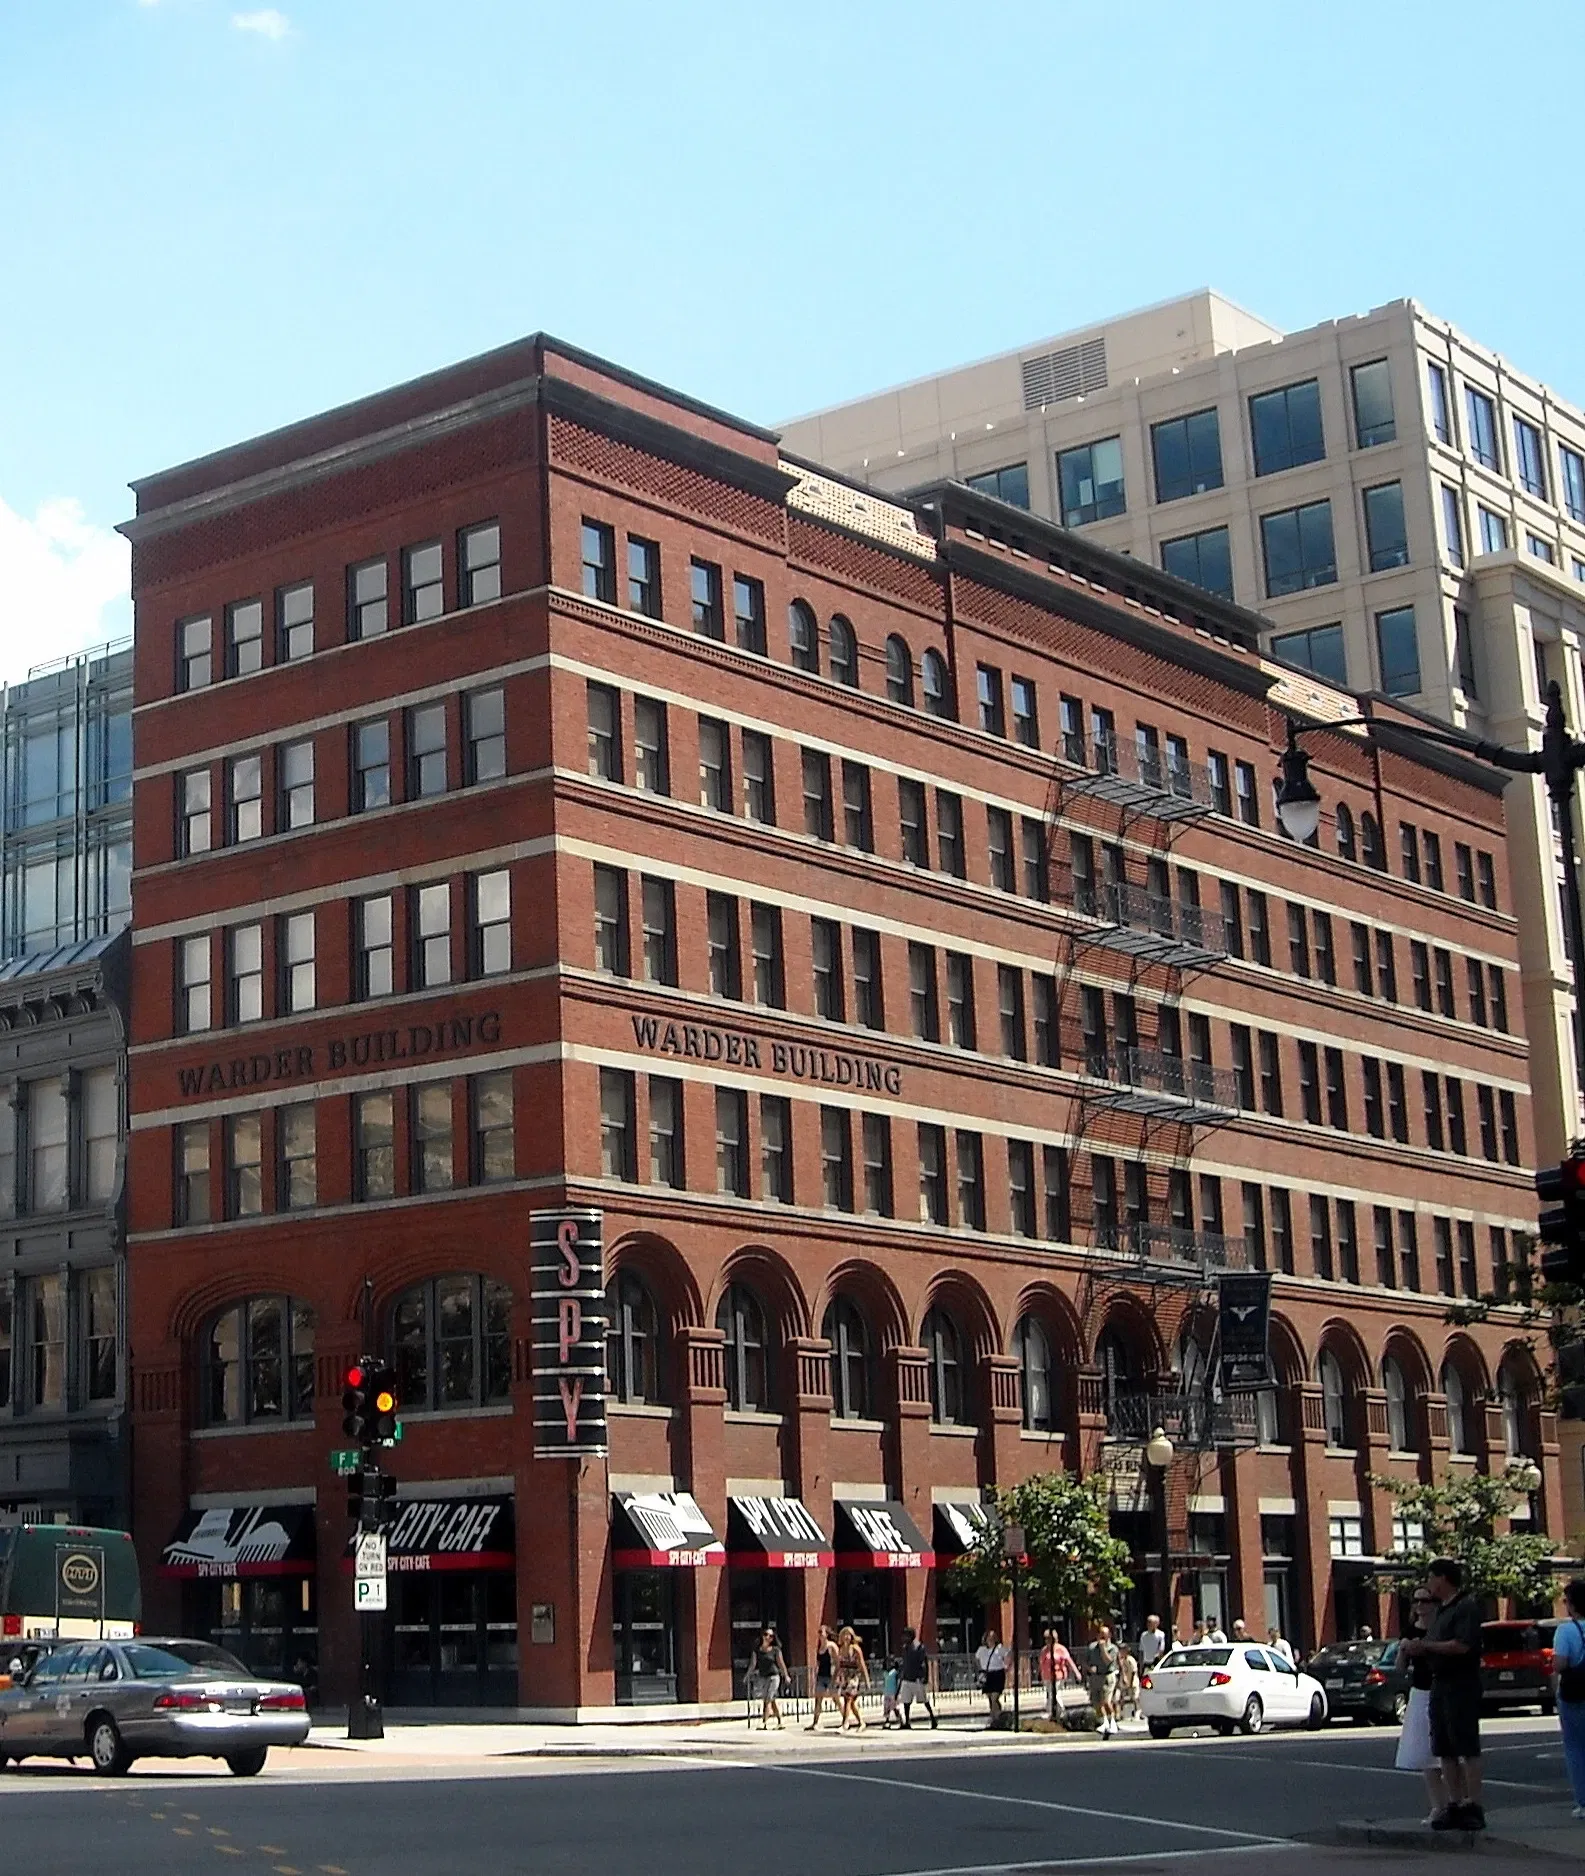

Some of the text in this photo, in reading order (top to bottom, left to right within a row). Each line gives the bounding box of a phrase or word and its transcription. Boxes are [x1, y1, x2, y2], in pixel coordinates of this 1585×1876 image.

[177, 1011, 501, 1097] WARDER BUILDING
[631, 1015, 901, 1096] WARDER BUILDING
[557, 1219, 585, 1442] SPY
[339, 1452, 346, 1466] F
[389, 1503, 450, 1549] CITY
[438, 1504, 501, 1552] CAFE
[731, 1495, 825, 1542] SPY CITY
[851, 1506, 913, 1553] CAFE
[359, 1563, 384, 1572] ON RED
[363, 1551, 380, 1561] TURN
[365, 1541, 377, 1550] NO
[358, 1582, 370, 1602] P
